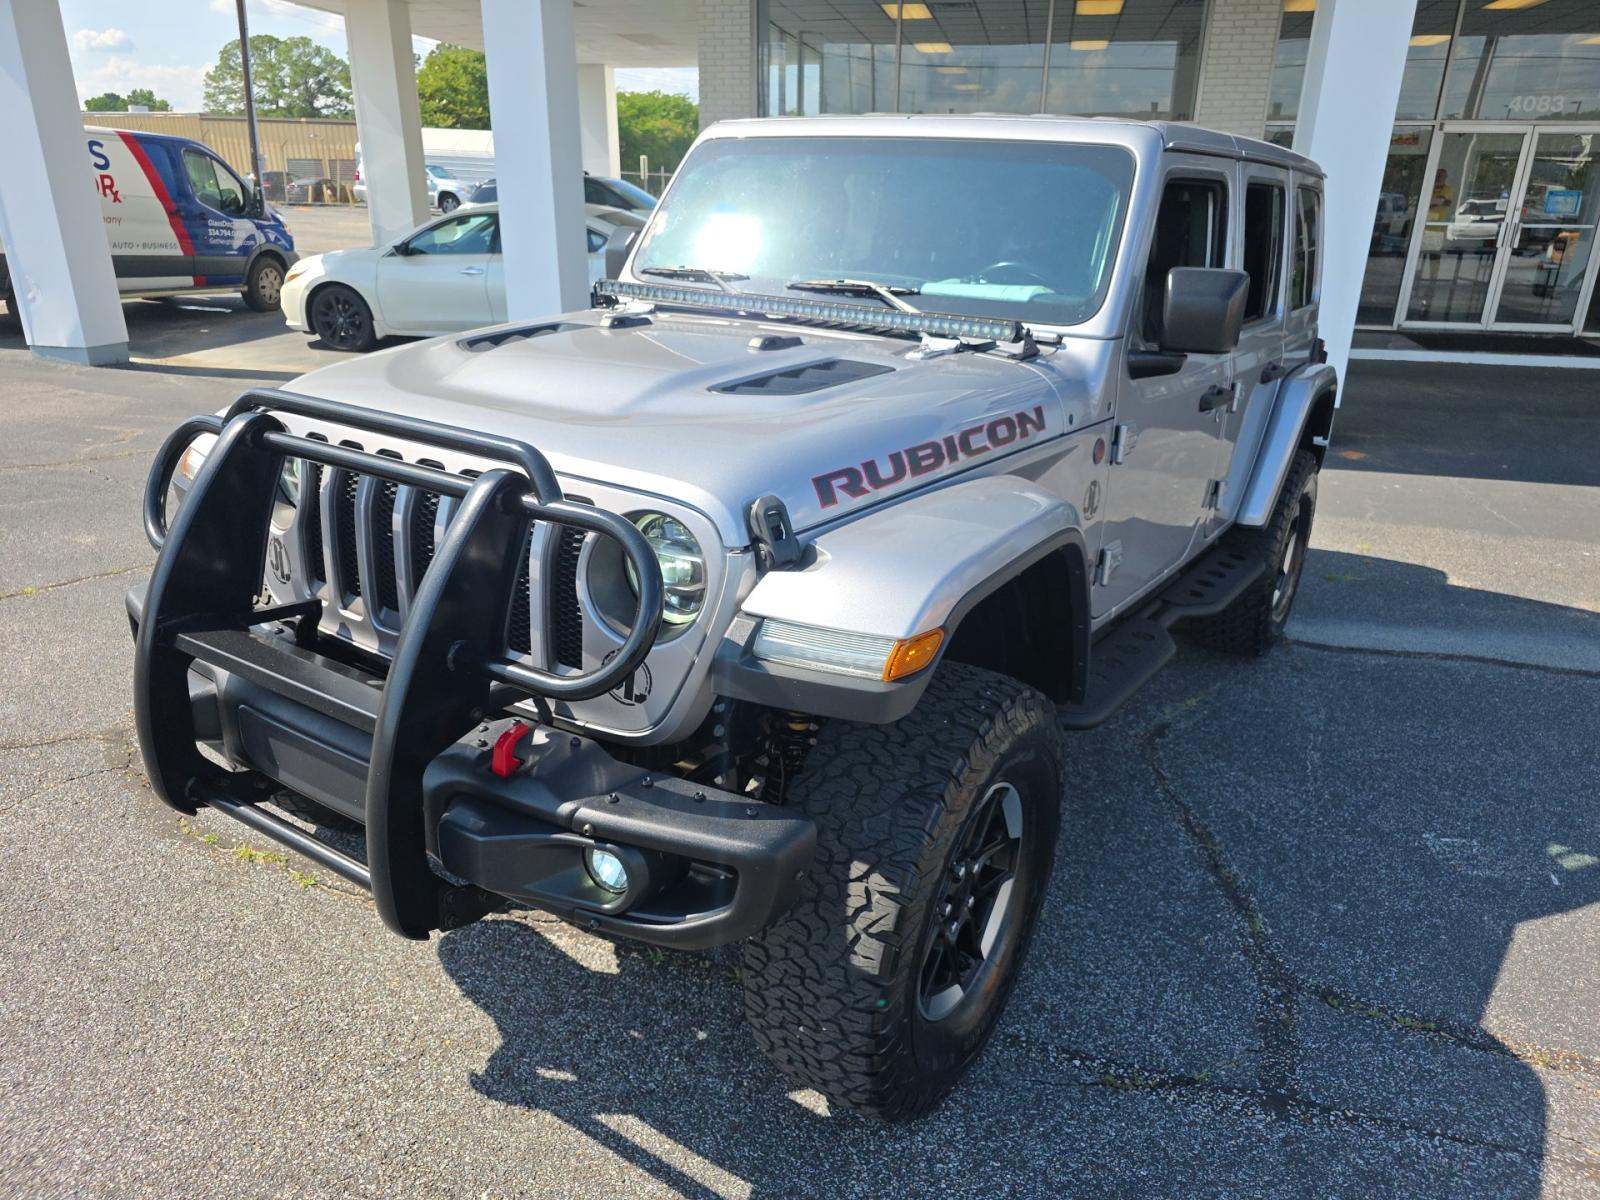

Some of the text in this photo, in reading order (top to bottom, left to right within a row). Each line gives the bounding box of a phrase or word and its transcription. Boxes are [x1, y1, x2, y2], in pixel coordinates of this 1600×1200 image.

[1509, 94, 1564, 112] 4083
[112, 241, 178, 250] AUTO BUSINESS
[811, 405, 1046, 509] RUBICON
